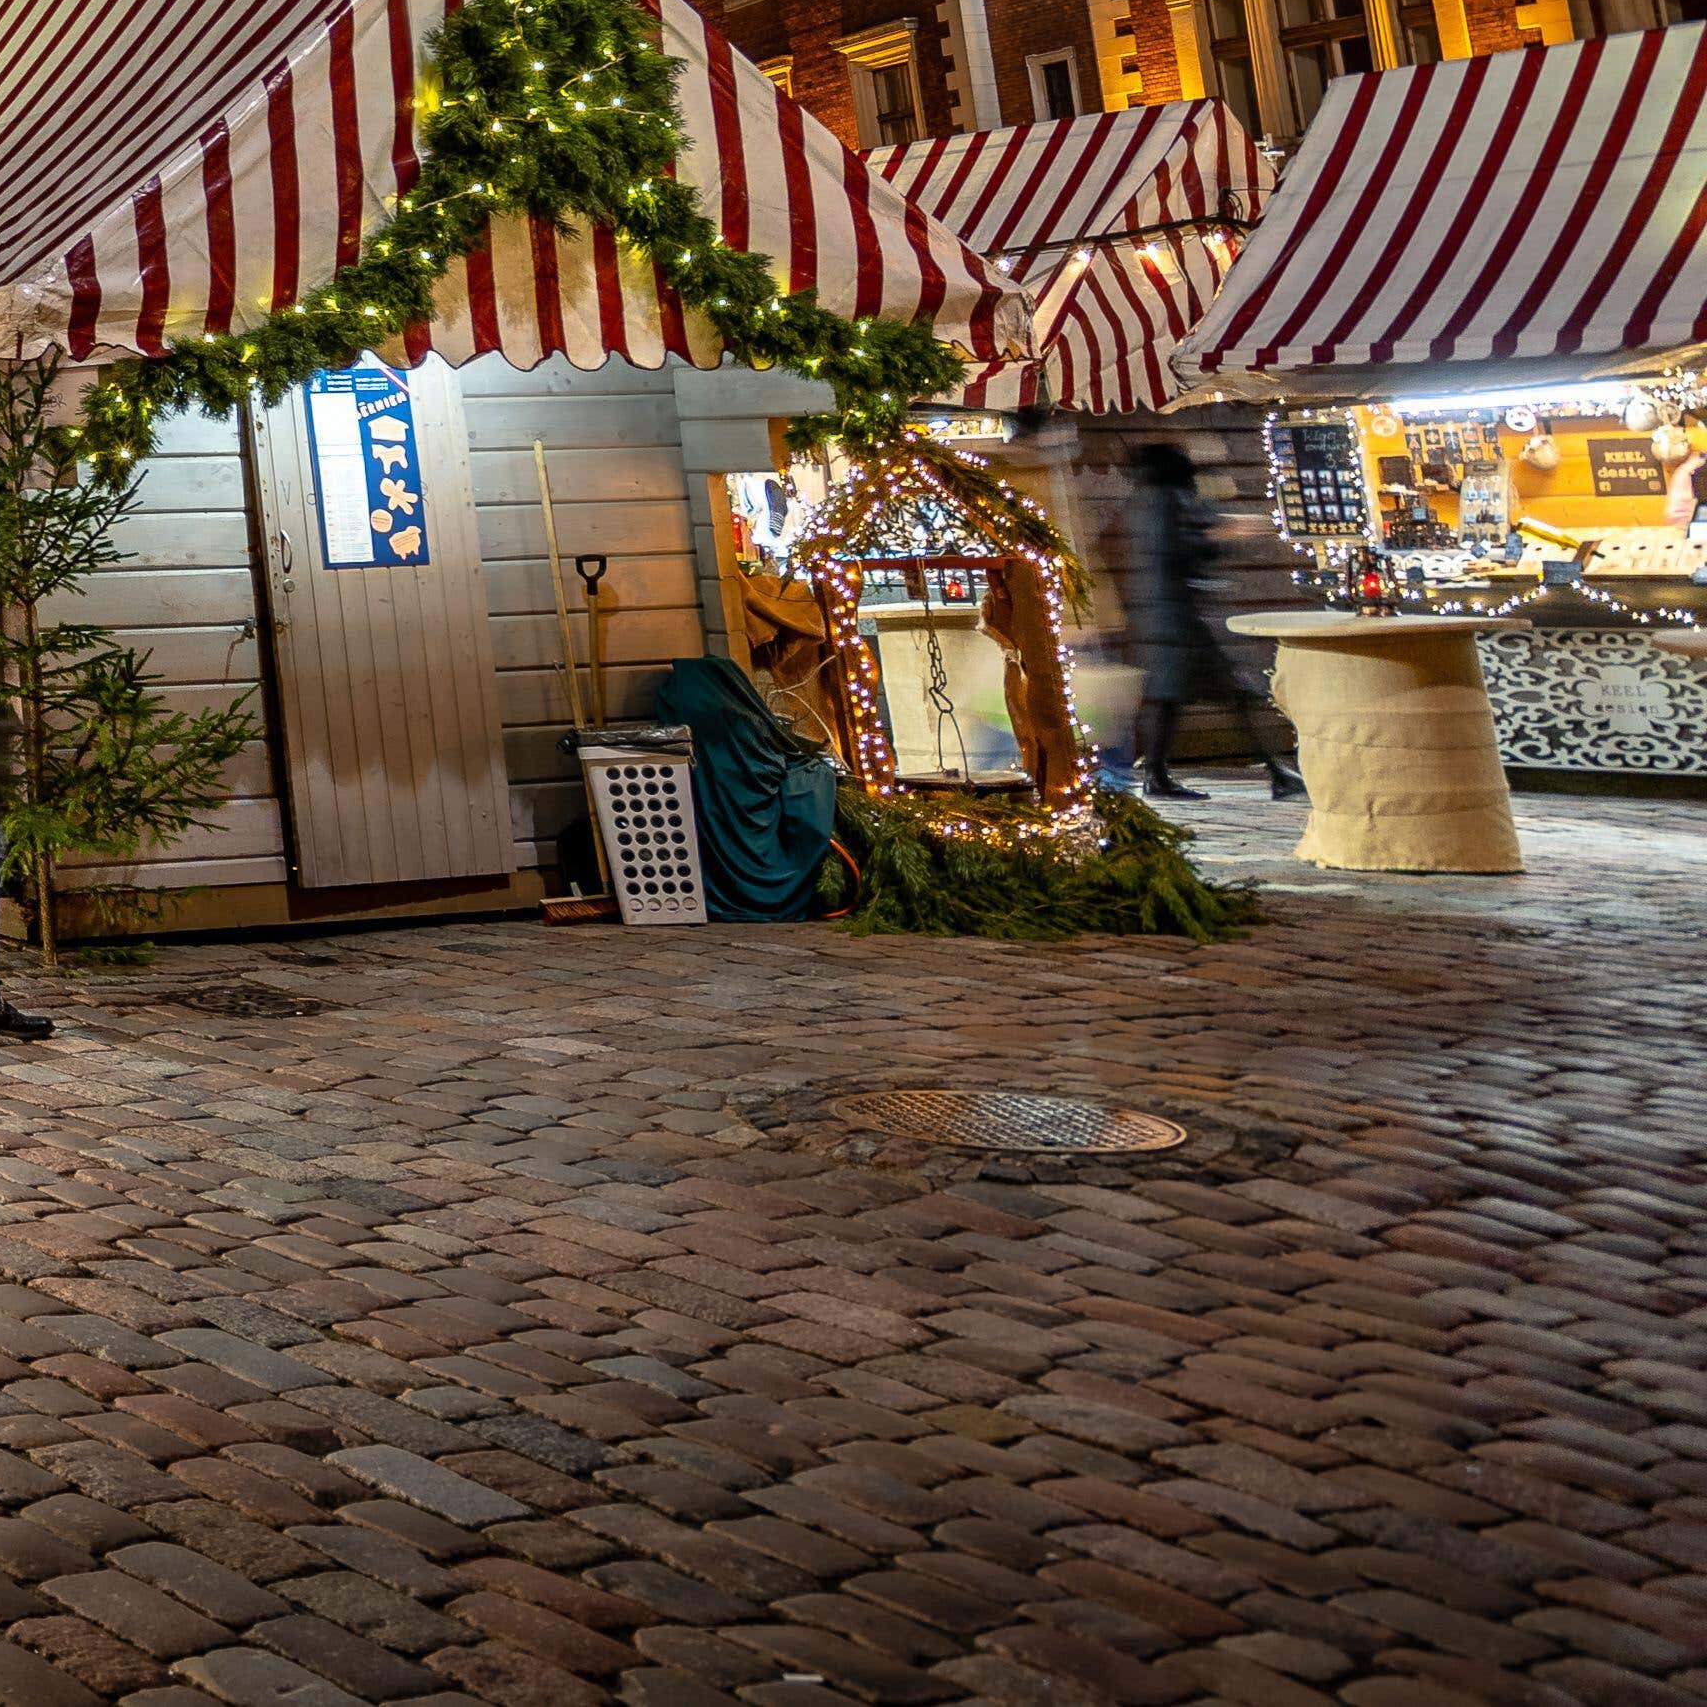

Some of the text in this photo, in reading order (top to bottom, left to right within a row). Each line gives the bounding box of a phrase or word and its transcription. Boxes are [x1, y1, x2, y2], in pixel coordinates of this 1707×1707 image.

[1604, 452, 1646, 463] KEEL
[1598, 466, 1658, 480] design
[1601, 685, 1646, 696] KEEL
